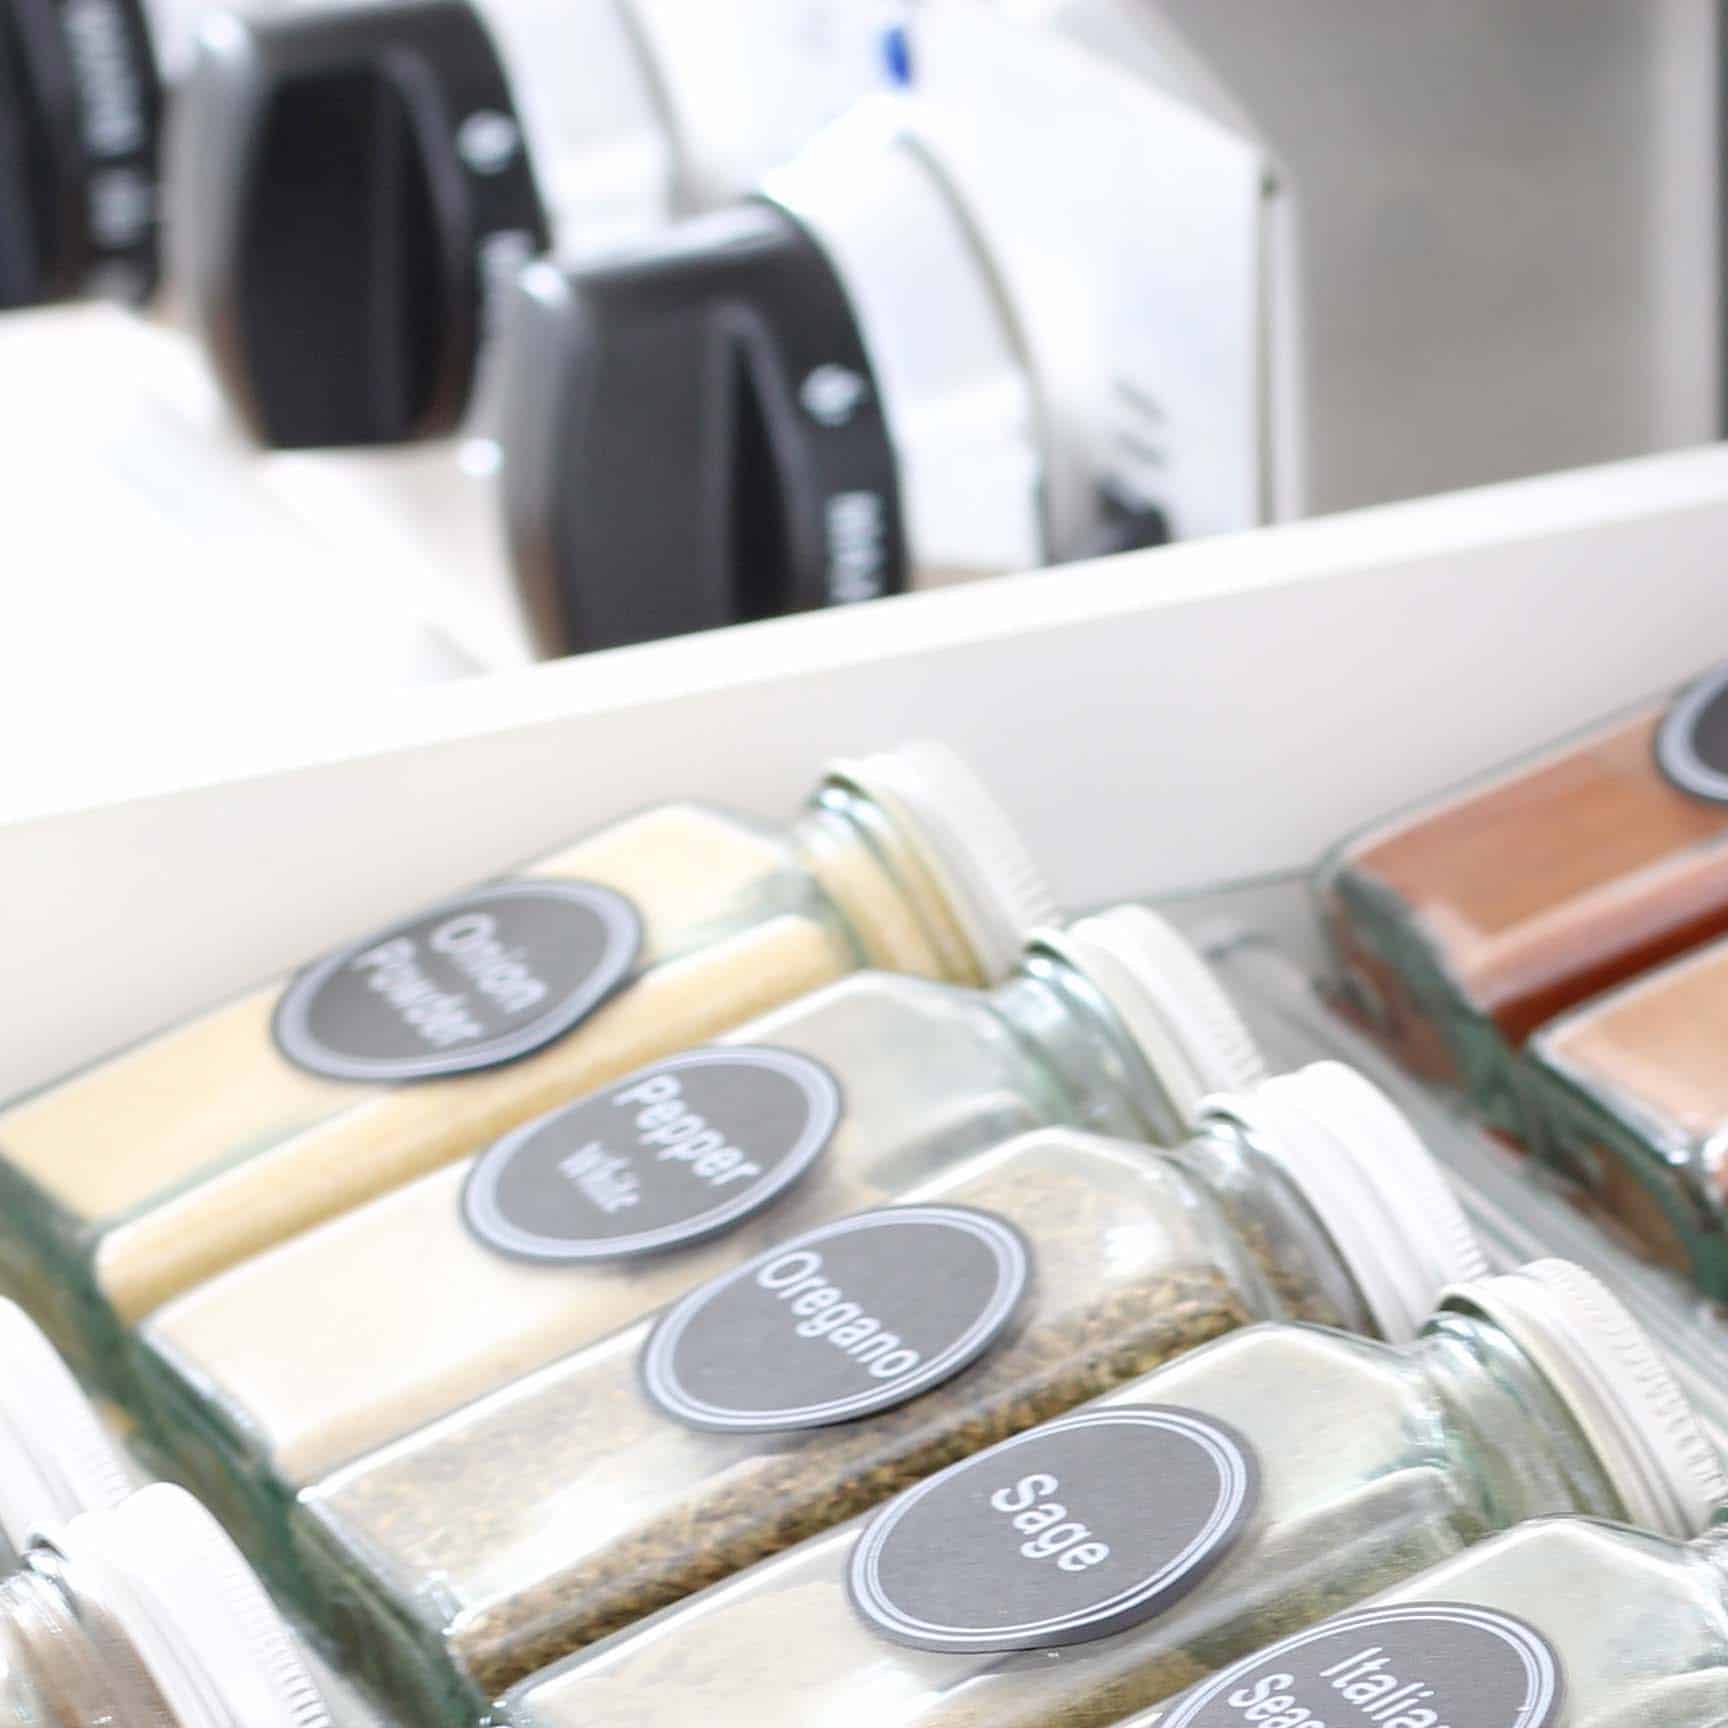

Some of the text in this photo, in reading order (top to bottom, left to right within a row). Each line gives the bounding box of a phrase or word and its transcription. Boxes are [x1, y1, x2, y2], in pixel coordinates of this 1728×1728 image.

[351, 938, 483, 1046] Powder
[430, 913, 547, 1014] Onion
[556, 1140, 641, 1214] White
[611, 1074, 760, 1186] Pepper
[754, 1247, 929, 1383] Oregano
[987, 1469, 1111, 1578] Sage
